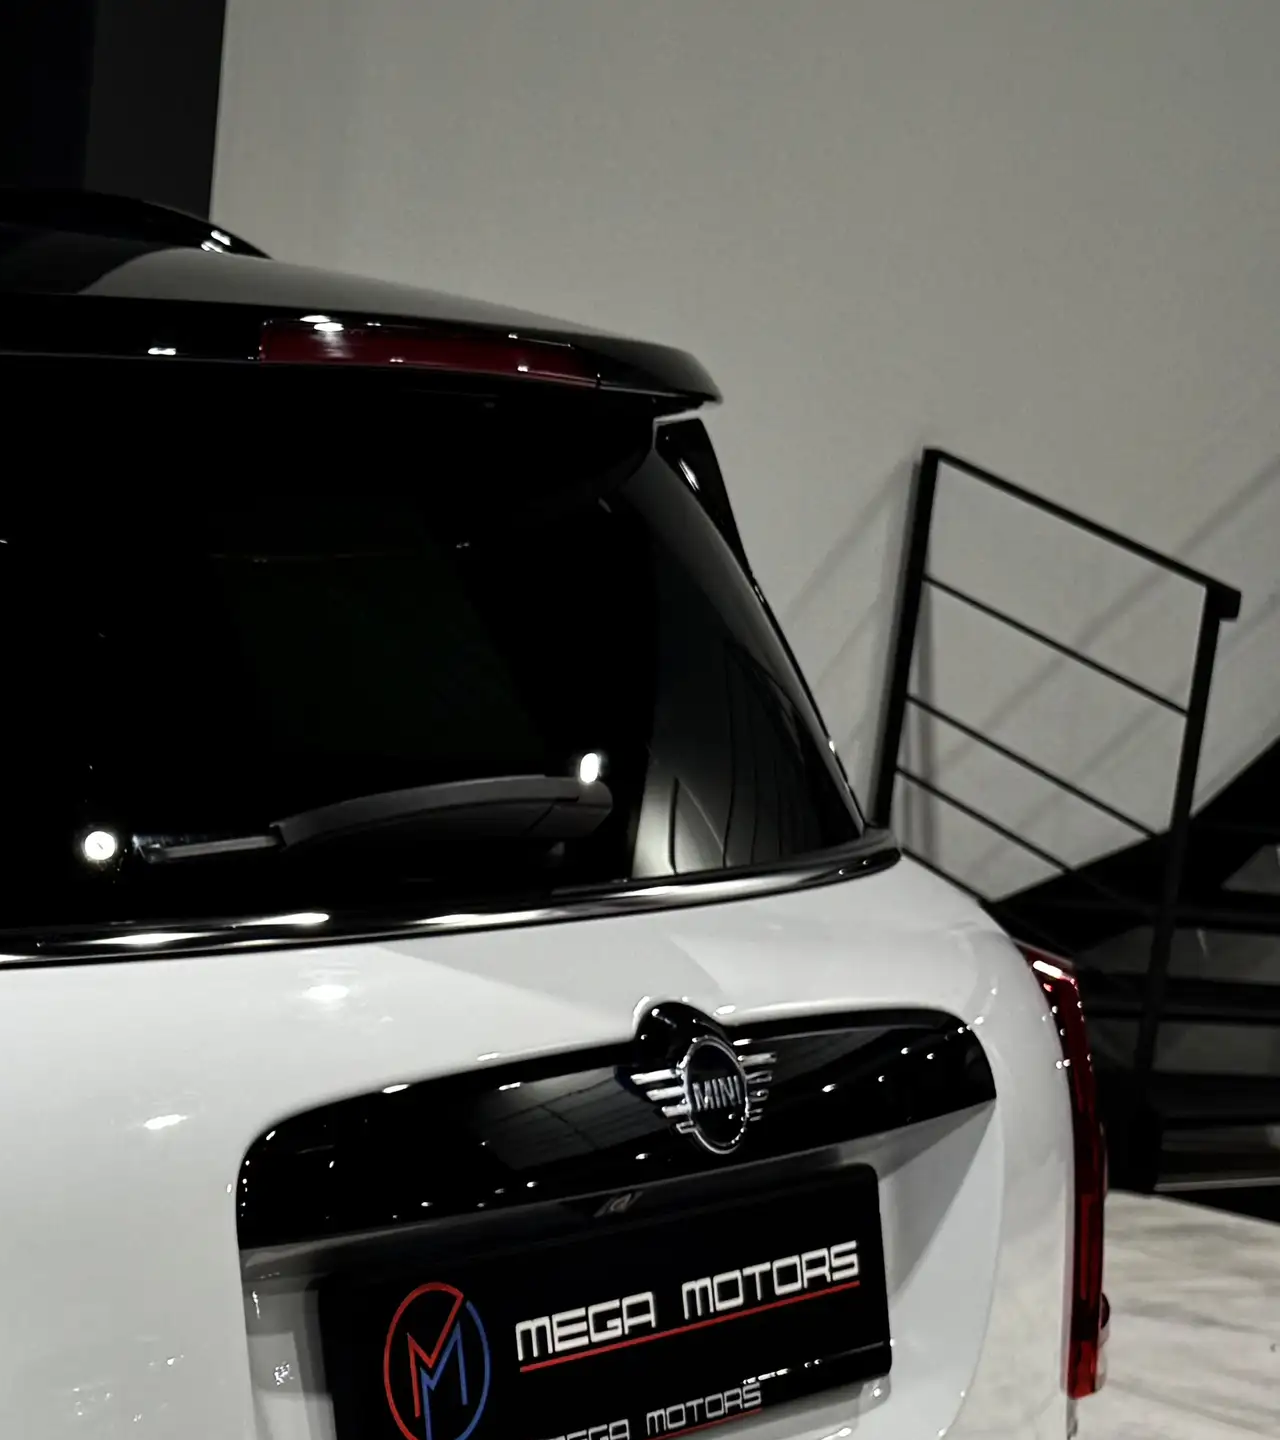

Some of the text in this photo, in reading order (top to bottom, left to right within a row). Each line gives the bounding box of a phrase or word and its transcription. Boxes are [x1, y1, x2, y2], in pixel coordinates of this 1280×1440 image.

[692, 1074, 743, 1113] MINI
[515, 1239, 860, 1363] MEGA MOTORS
[645, 1381, 763, 1437] MOTORS
